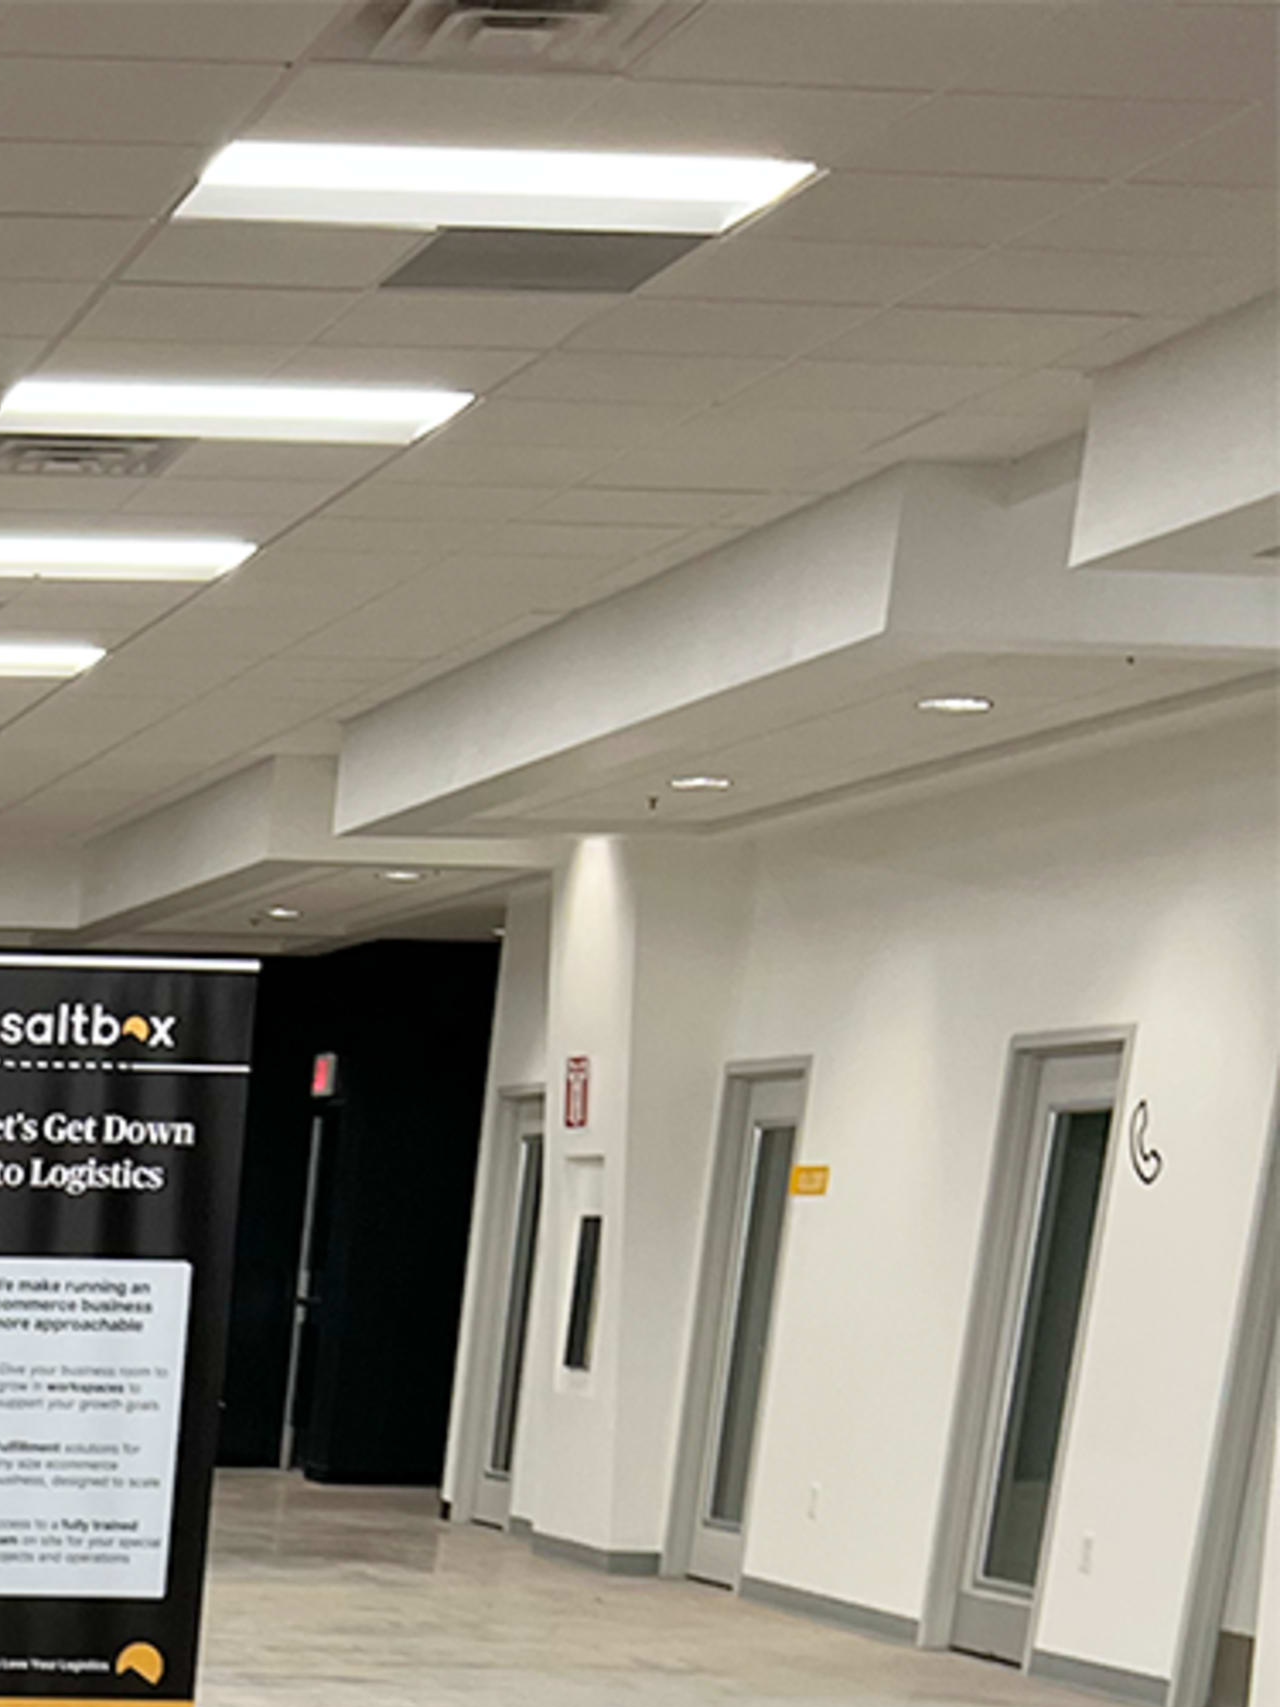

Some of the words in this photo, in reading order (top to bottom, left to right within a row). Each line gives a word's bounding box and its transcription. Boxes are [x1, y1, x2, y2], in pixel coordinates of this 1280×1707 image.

[0, 1003, 175, 1047] saltbox
[44, 1113, 97, 1144] Get
[103, 1114, 195, 1146] Down
[30, 1159, 164, 1193] Logistics
[18, 1279, 60, 1292] make
[65, 1281, 126, 1296] running
[131, 1283, 151, 1294] an
[81, 1299, 152, 1313] business
